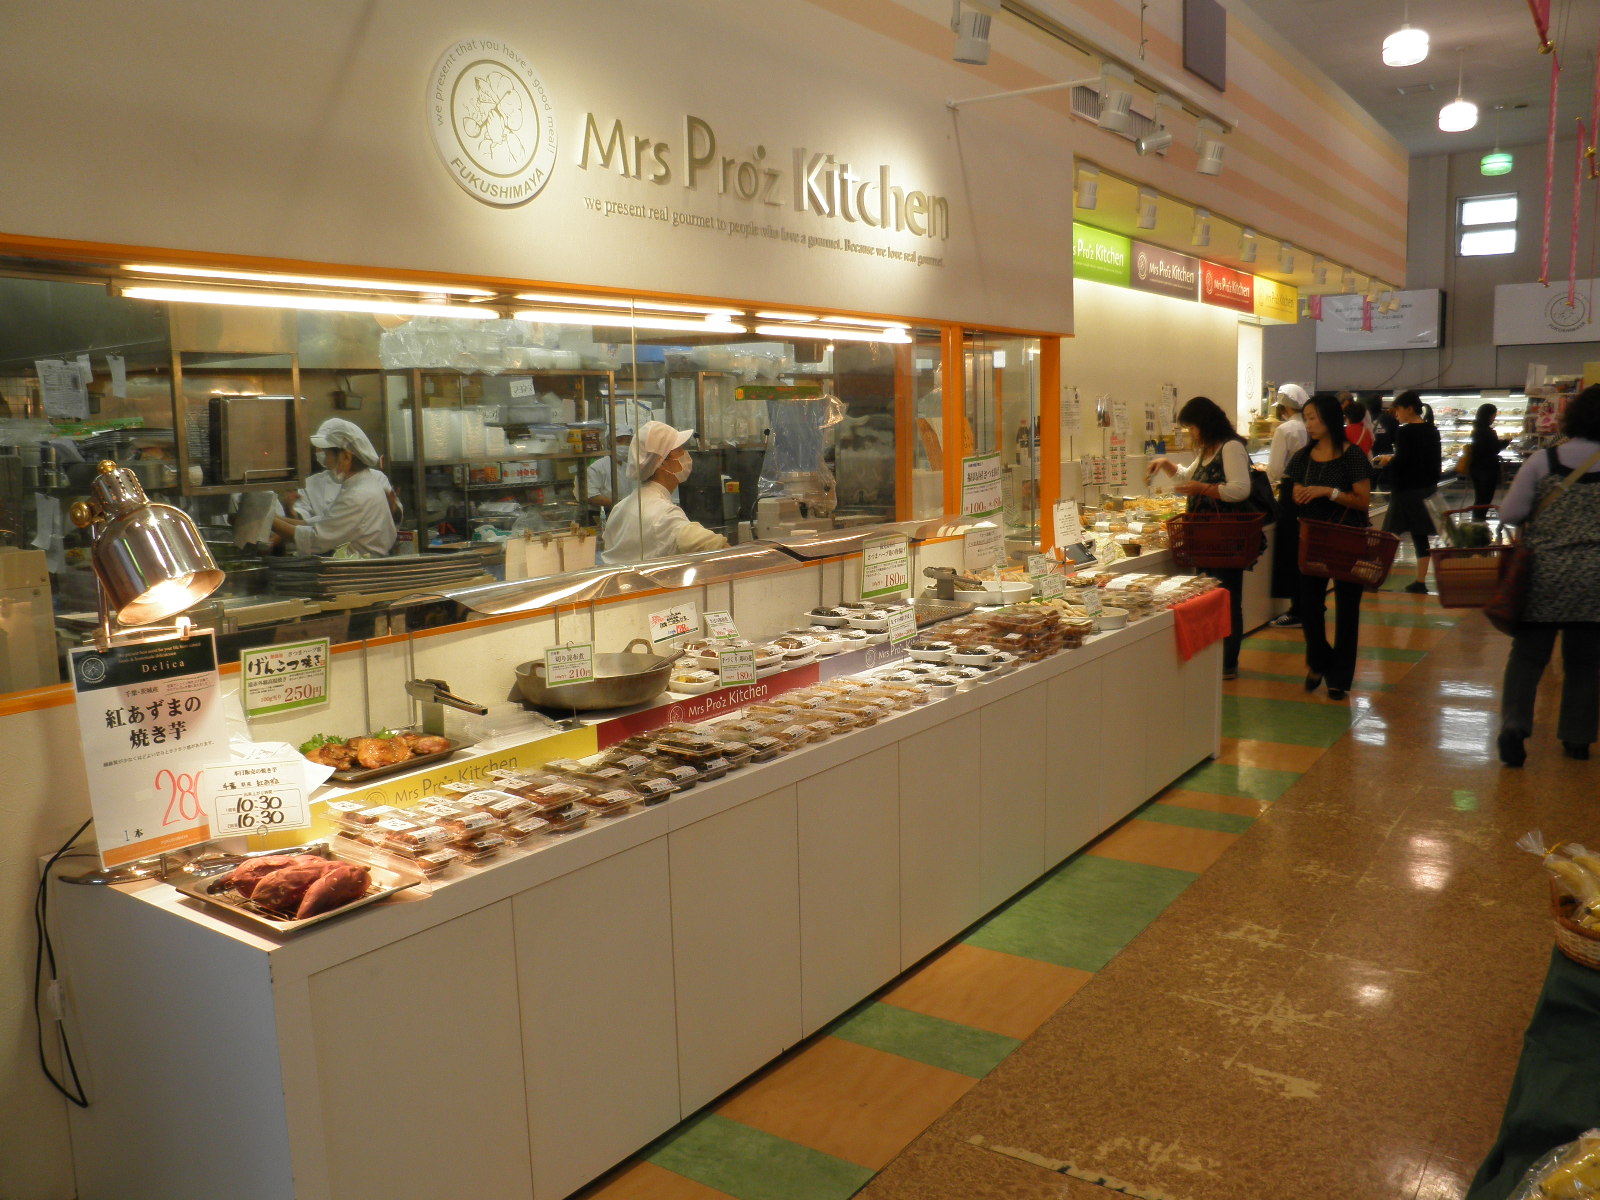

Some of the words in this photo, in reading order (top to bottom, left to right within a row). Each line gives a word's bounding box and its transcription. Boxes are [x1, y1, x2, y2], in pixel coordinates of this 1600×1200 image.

[456, 40, 476, 56] that
[480, 40, 499, 51] you
[503, 43, 527, 67] have
[435, 53, 457, 102] present
[533, 79, 552, 111] good
[434, 105, 443, 127] we
[451, 157, 544, 199] FUKUSHIMAYA
[577, 112, 671, 185] Mrs
[793, 148, 949, 241] Kitchen
[584, 197, 601, 211] we
[604, 199, 646, 217] present
[648, 206, 669, 222] real
[672, 211, 714, 227] gourmet
[715, 218, 726, 231] to
[729, 221, 758, 238] people
[781, 227, 799, 242] love
[800, 235, 807, 243] a
[844, 239, 875, 255] Because
[876, 247, 887, 258] we
[888, 247, 903, 260] love
[904, 250, 917, 264] real
[1095, 243, 1124, 267] Kitchen
[1149, 262, 1159, 276] Mrs
[1172, 264, 1195, 284] Kitchen
[1214, 279, 1222, 291] Mrs
[1232, 279, 1250, 298] Kitchen
[142, 660, 185, 673] Delica
[248, 655, 321, 676] げんこつ焼き
[879, 651, 890, 659] Mrs
[285, 684, 322, 702] 250円
[688, 705, 705, 717] Mrs
[729, 684, 768, 705] Kitchen
[105, 696, 202, 729] 紅あずまの
[130, 721, 188, 750] 焼き芋
[394, 786, 419, 804] Mrs
[458, 756, 518, 781] Kitchen
[237, 796, 282, 813] 10:30
[238, 811, 284, 828] 16:30
